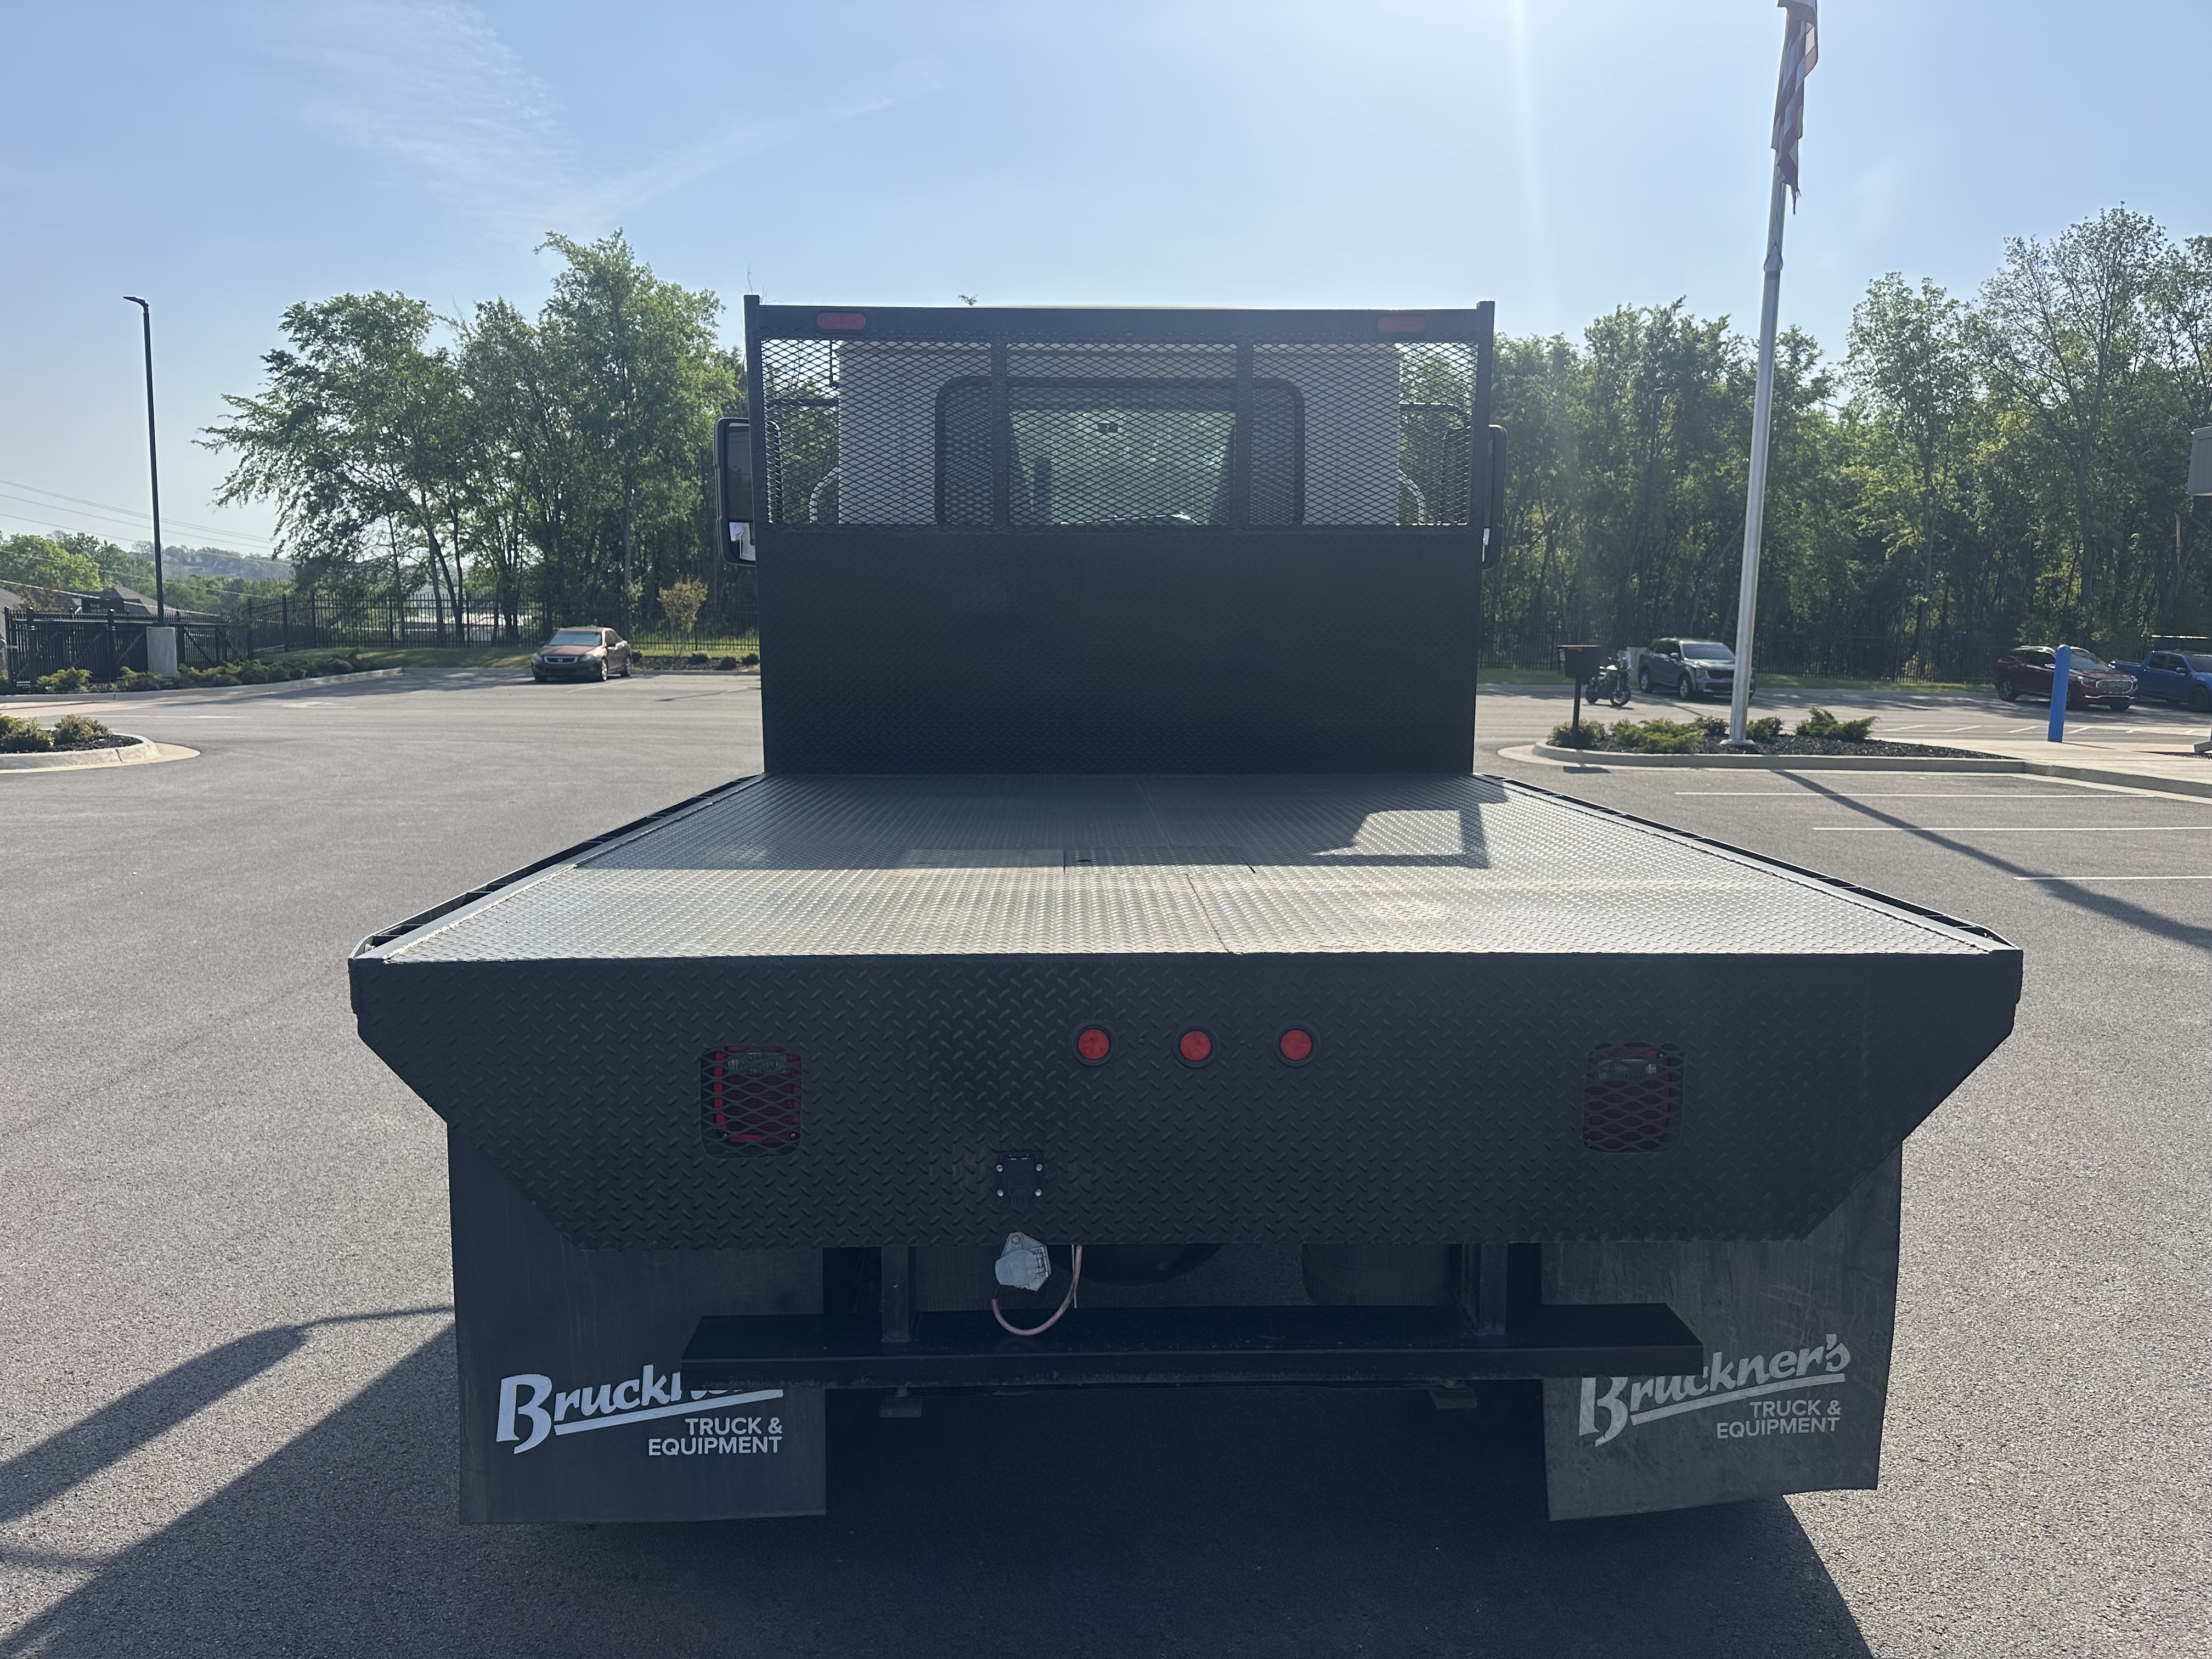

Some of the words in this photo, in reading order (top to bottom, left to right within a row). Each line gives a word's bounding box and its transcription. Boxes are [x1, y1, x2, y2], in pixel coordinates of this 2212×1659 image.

[1578, 1333, 1851, 1447] Bruckner's
[1749, 1399, 1821, 1419] TRUCK
[1826, 1400, 1842, 1415] &
[685, 1417, 762, 1436] TRUCK
[768, 1417, 783, 1434] &
[1716, 1417, 1840, 1440] EQUIPMENT
[648, 1436, 783, 1456] EQUIPMENT
